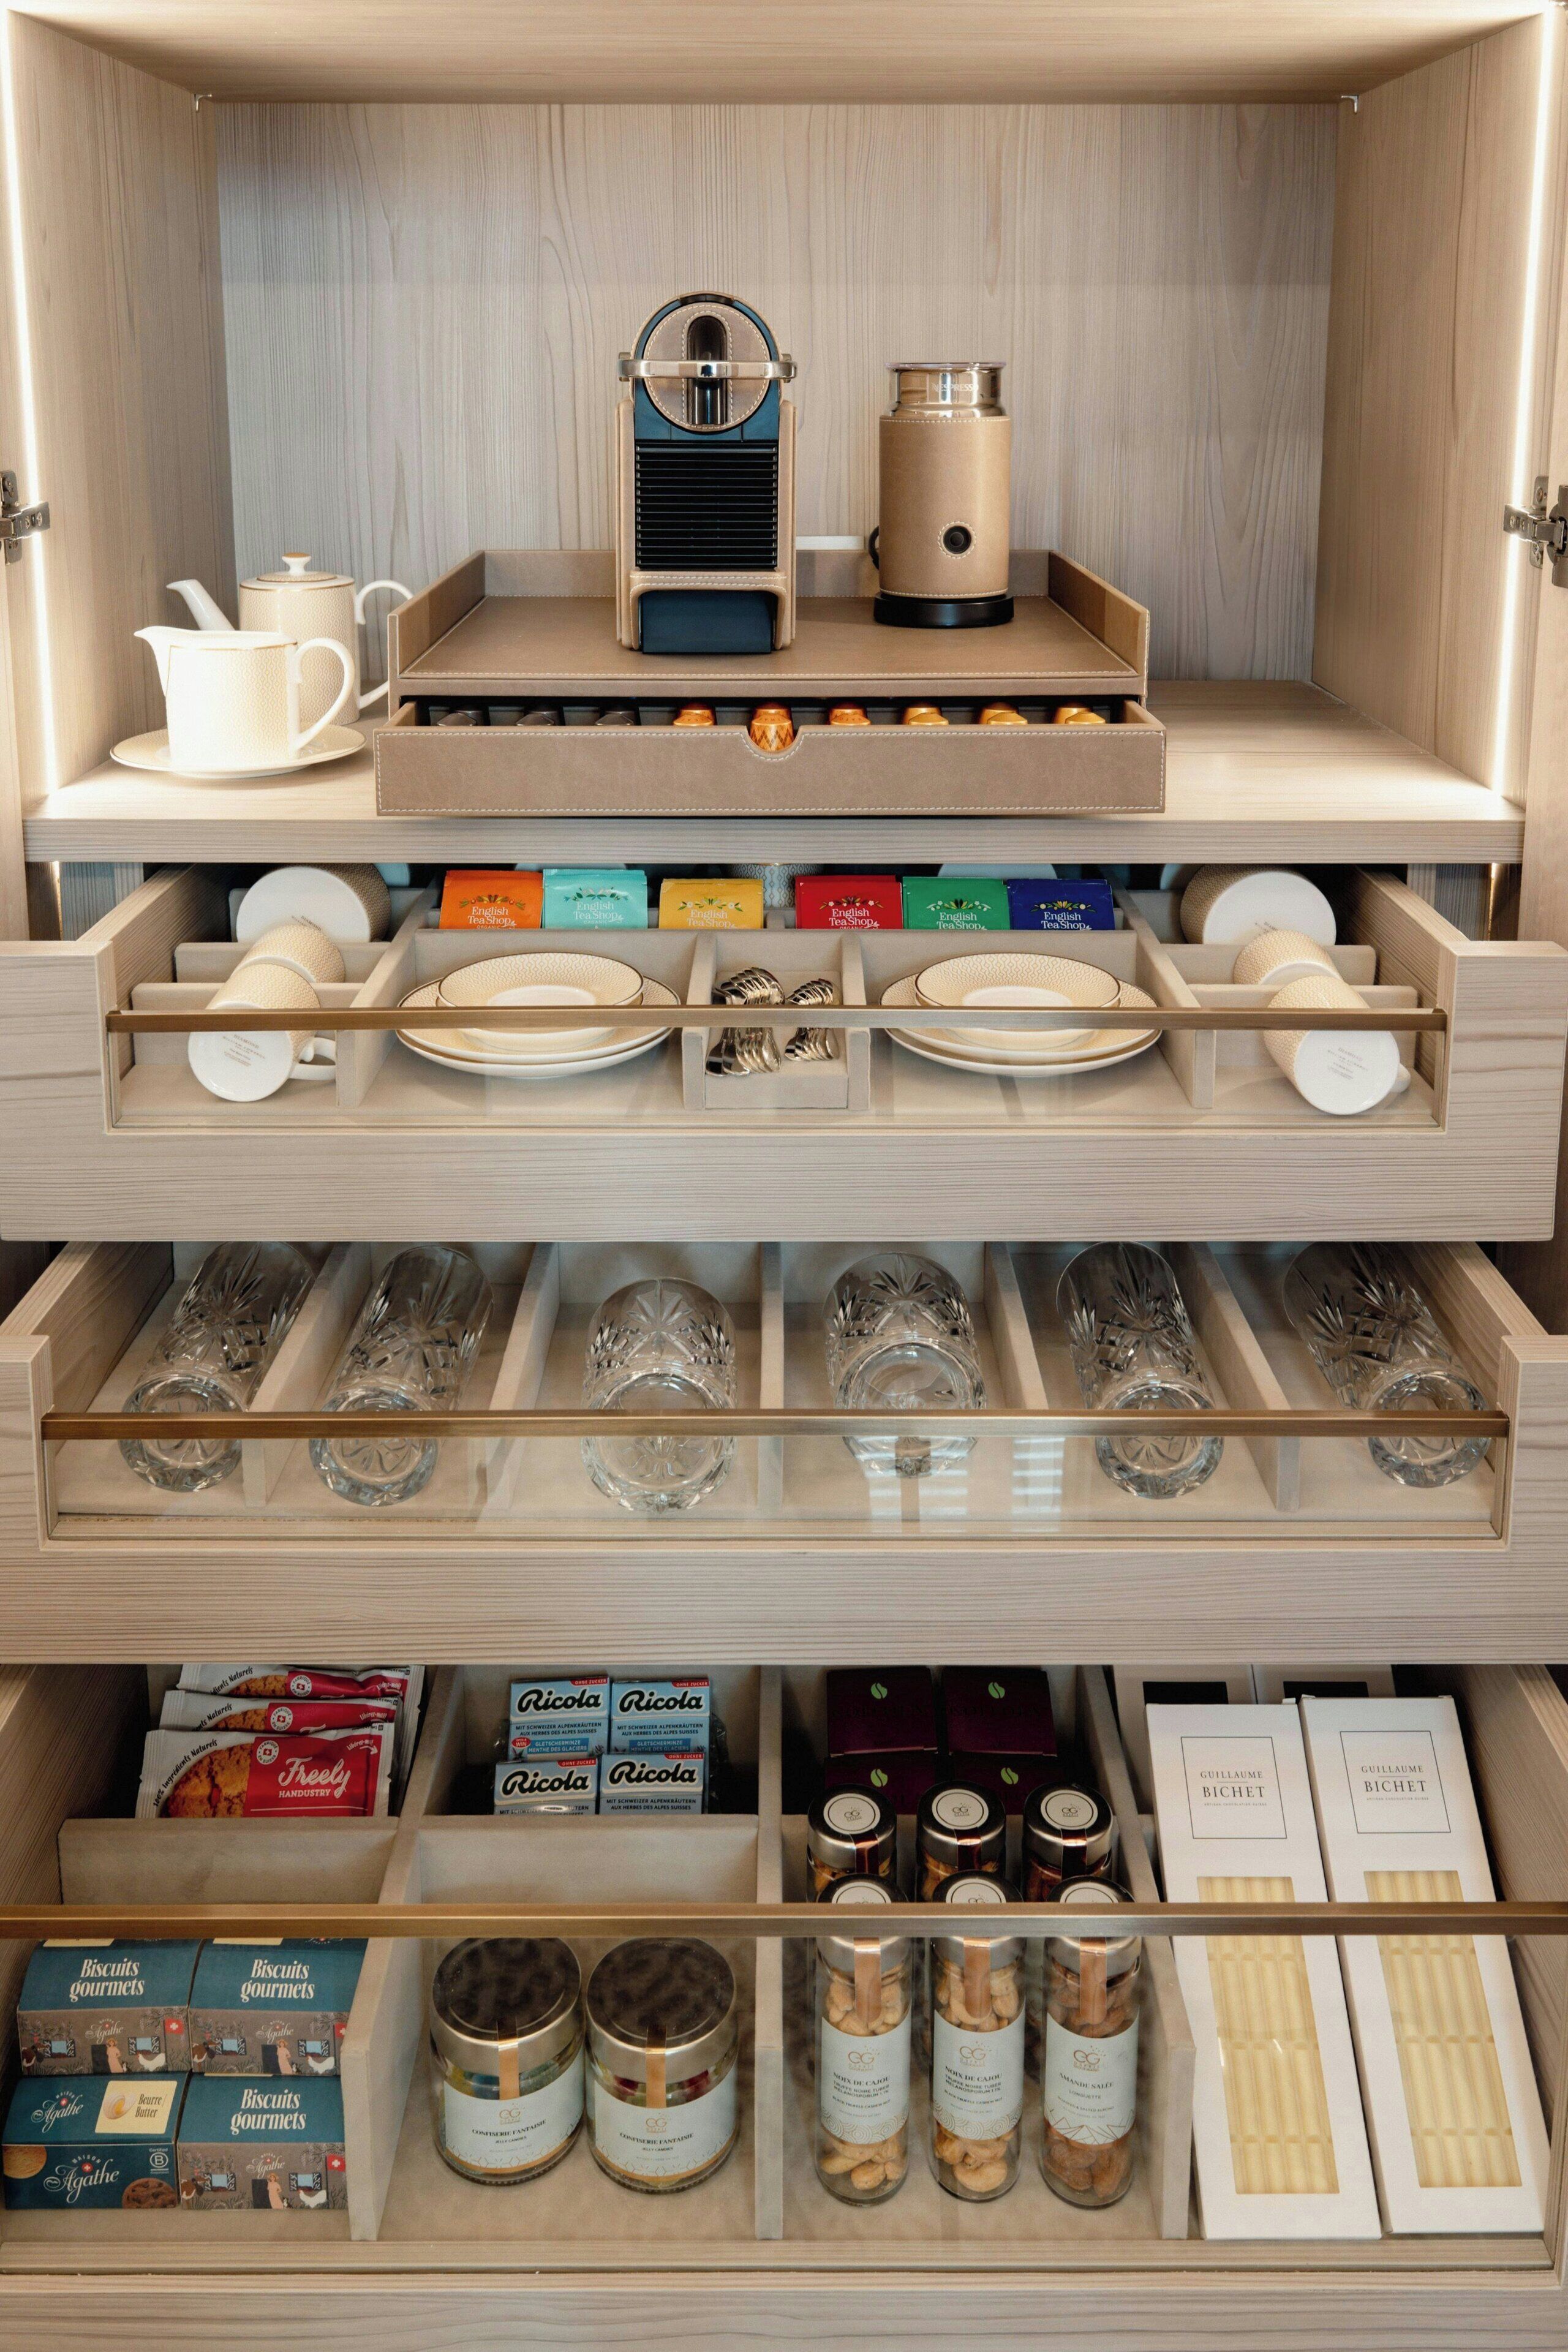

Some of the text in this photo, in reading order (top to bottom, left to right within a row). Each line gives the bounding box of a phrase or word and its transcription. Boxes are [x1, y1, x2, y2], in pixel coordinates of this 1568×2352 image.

[472, 907, 508, 917] English
[577, 901, 614, 912] English
[691, 909, 728, 919] English
[832, 908, 870, 919] English
[468, 916, 511, 927] Tea Shop
[593, 911, 618, 922] Shop
[687, 918, 731, 929] Tea Shop
[829, 918, 873, 928] Tea Shop
[940, 912, 977, 922] English
[1044, 911, 1082, 922] English
[937, 921, 981, 930] Tea Shop
[1060, 921, 1086, 930] Shop
[228, 1666, 253, 1683] Naturels
[518, 1689, 601, 1713] Ricola
[619, 1690, 703, 1713] Ricola
[206, 1703, 232, 1721] Naturels
[153, 1789, 164, 1807] 100%
[162, 1755, 191, 1789] Ingrédients
[190, 1739, 217, 1757] Naturels
[278, 1757, 351, 1798] Freely
[609, 1761, 696, 1784] Ricola
[502, 1770, 589, 1795] Ricola
[1364, 1781, 1426, 1792] BICHET
[279, 1789, 331, 1798] HANDUSTRY
[1202, 1786, 1264, 1798] BICHET
[80, 1958, 140, 1977] Biscuits
[251, 1959, 309, 1979] Biscuits
[69, 1978, 145, 2002] gourmets
[240, 1980, 315, 2003] gourmets
[85, 2021, 124, 2044] Agathe
[255, 2022, 294, 2045] Agathe
[833, 2072, 851, 2084] NOIX
[865, 2075, 890, 2086] CAJOU
[946, 2065, 962, 2079] NOIX
[977, 2073, 1002, 2082] CAJOU
[1060, 2073, 1087, 2088] AMANDE
[241, 2089, 301, 2109] Biscuits
[31, 2094, 83, 2133] Agathe
[135, 2106, 158, 2117] Butter
[230, 2111, 306, 2135] gourmets
[513, 2119, 546, 2135] FANTAISIE
[620, 2132, 694, 2144] CONFISERIE FANTAISIE
[72, 2154, 101, 2164] MAISON
[246, 2155, 285, 2179] Agathe
[43, 2158, 119, 2204] Agathe
